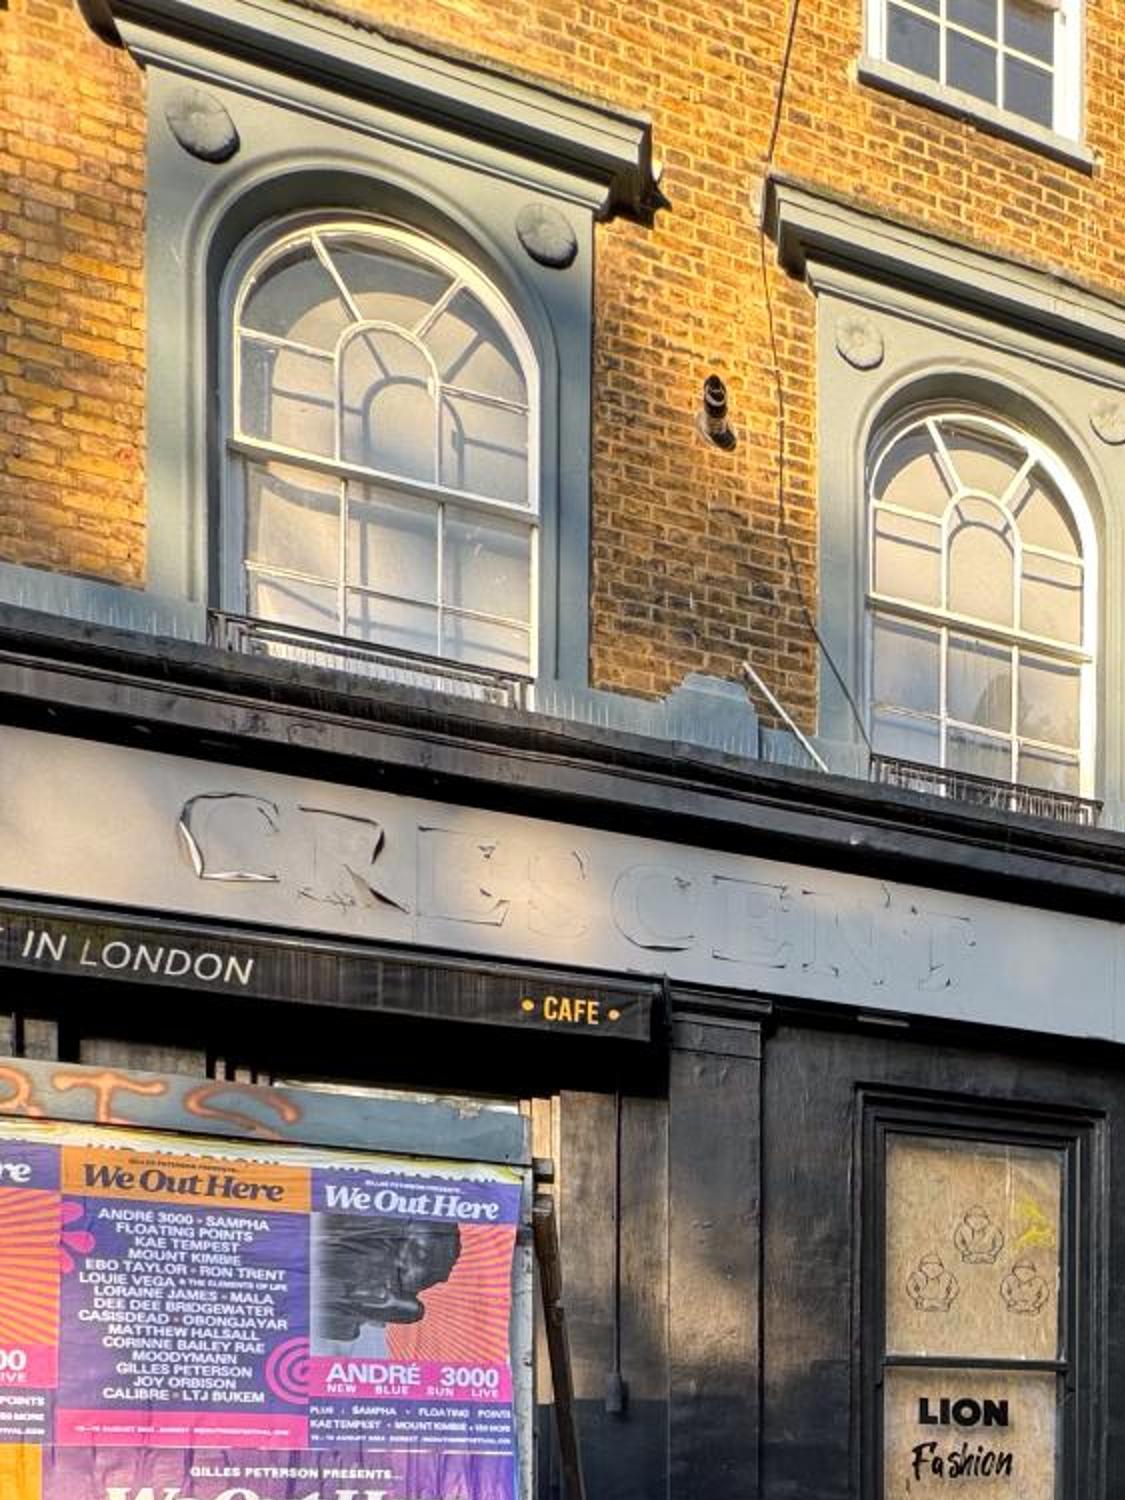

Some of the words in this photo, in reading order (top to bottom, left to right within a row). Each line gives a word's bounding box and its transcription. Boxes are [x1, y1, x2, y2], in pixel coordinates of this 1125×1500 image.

[22, 930, 67, 960] IN
[80, 940, 254, 985] LONDON
[544, 995, 599, 1025] CAFE
[83, 1163, 134, 1189] We
[140, 1169, 203, 1196] Out
[203, 1173, 284, 1202] Here
[325, 1184, 370, 1209] We
[374, 1189, 431, 1215] Out
[431, 1193, 500, 1220] Here
[98, 1206, 155, 1222] ANDRÉ
[158, 1213, 193, 1225] 3000
[206, 1215, 270, 1232] SAMPHA
[116, 1222, 194, 1238] FLOATING
[200, 1227, 253, 1243] POINTS
[135, 1237, 167, 1249] KAE
[173, 1239, 241, 1254] TEMPEST
[128, 1249, 186, 1262] MOUNT
[191, 1253, 241, 1266] KIMBIE
[79, 1272, 128, 1285] LOUIE
[132, 1275, 176, 1287] VEGA
[85, 1259, 119, 1270] EBO
[123, 1261, 187, 1275] TAYLOR
[200, 1266, 233, 1278] RON
[237, 1268, 287, 1282] TRENT
[94, 1286, 165, 1298] LORAINE
[168, 1290, 217, 1302] JAMES
[230, 1292, 274, 1305] MALA
[94, 1298, 126, 1310] DEE
[130, 1300, 161, 1312] DEE
[165, 1302, 275, 1317] BRIDGEWATER
[78, 1310, 169, 1325] CASISDEAD
[182, 1315, 288, 1331] OBONGJAYAR
[108, 1324, 187, 1337] MATTHEW
[191, 1328, 260, 1341] HALSALL
[103, 1336, 172, 1349] CORINNE
[177, 1338, 232, 1351] BAILEY
[235, 1342, 265, 1354] RAE
[132, 1351, 237, 1364] MOODYMANN
[116, 1362, 170, 1375] GILLES
[174, 1364, 252, 1377] PETERSON
[326, 1362, 421, 1385] ANDRÉ
[441, 1367, 499, 1388] 3000
[133, 1376, 164, 1388] JOY
[168, 1378, 236, 1389] ORBISON
[326, 1384, 357, 1393] NEW
[374, 1385, 410, 1395] BLUE
[471, 1388, 499, 1398] LIVE
[103, 1388, 169, 1400] CALIBRE
[183, 1389, 209, 1401] LTJ
[212, 1391, 265, 1403] BUKEM
[352, 1405, 397, 1416] SAMPHA
[919, 1398, 1009, 1427] LION
[912, 1441, 1013, 1480] Fashion
[190, 1467, 241, 1478] GILLES
[245, 1467, 319, 1479] PETERSON
